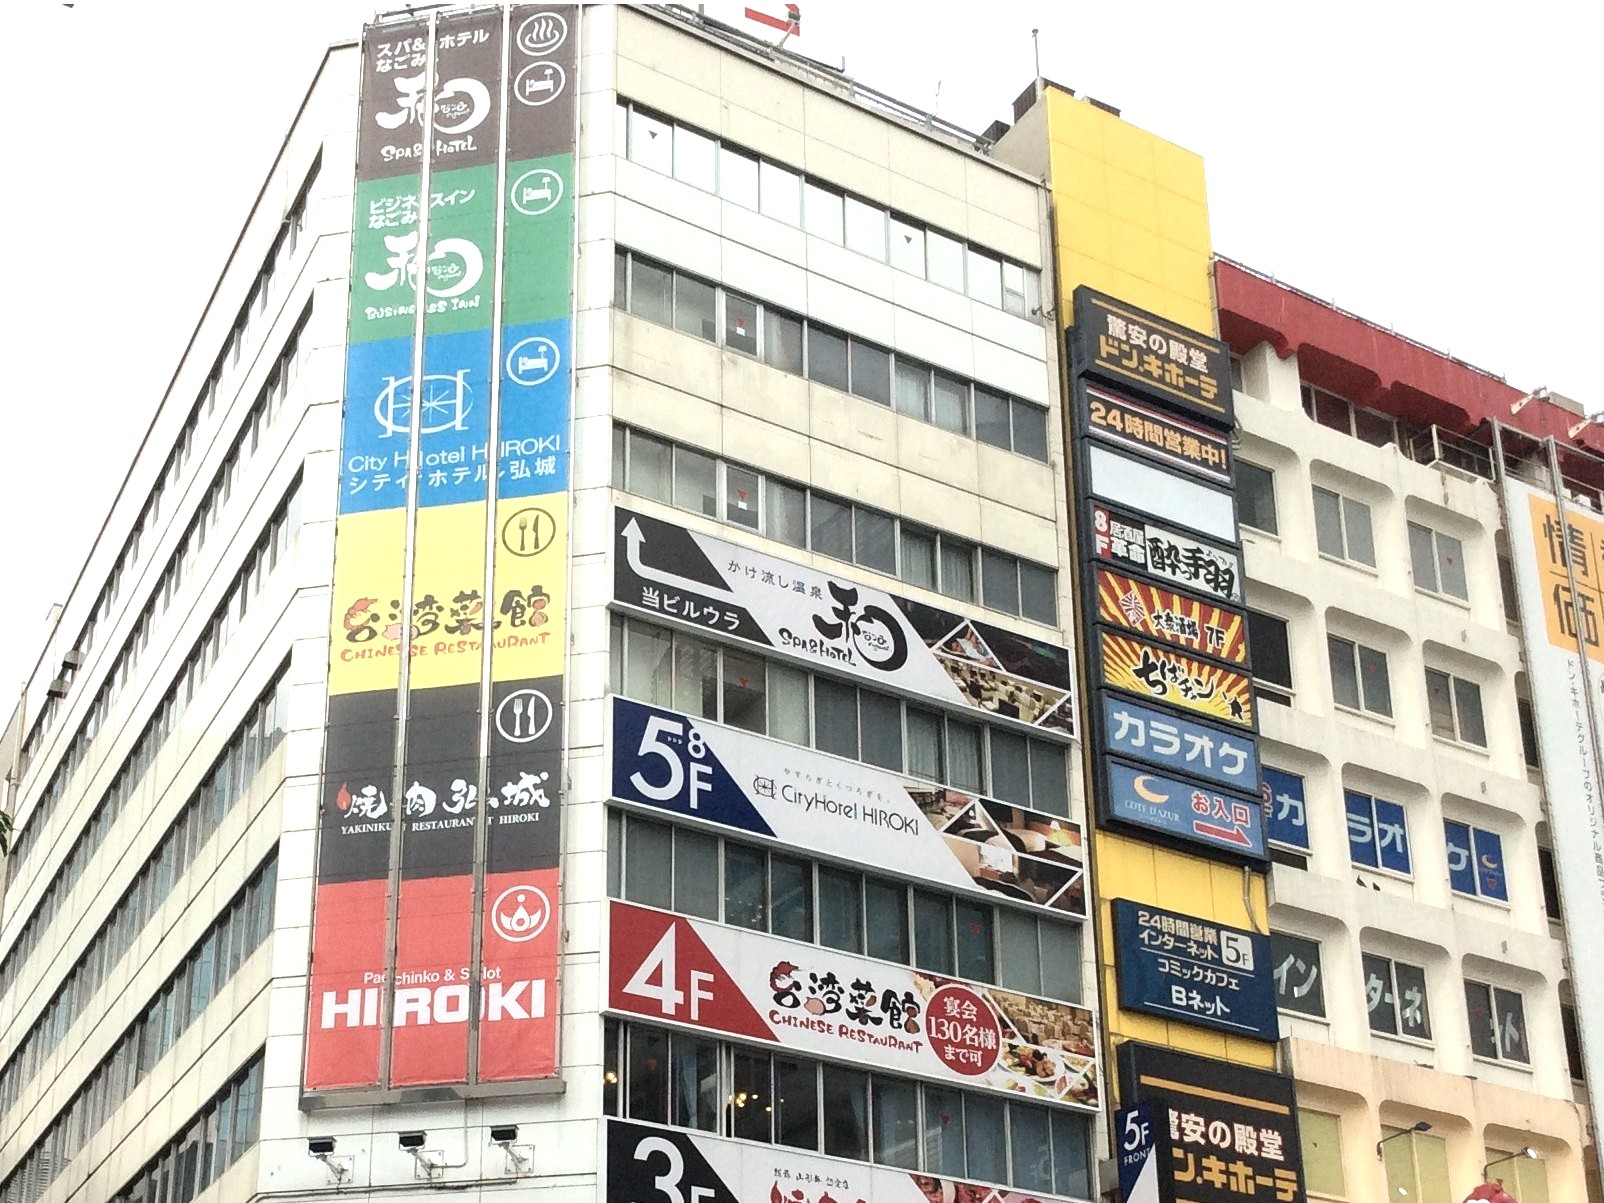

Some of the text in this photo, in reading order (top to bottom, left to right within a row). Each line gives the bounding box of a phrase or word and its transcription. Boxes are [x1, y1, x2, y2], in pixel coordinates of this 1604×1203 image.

[1107, 313, 1209, 373] 驚安の殿堂
[348, 435, 561, 475] City Hotel HIROKI
[728, 560, 824, 600] かけ流し温泉
[641, 586, 740, 631] 当ビルウラ
[340, 632, 551, 663] CHINESE RESTAURANT
[1112, 710, 1248, 776] カラオケ
[341, 812, 541, 836] YAKINIKU RESTAURANT HIROKI
[862, 804, 920, 837] HIROKI
[1191, 791, 1251, 829] お入口
[1138, 910, 1218, 946] 24時間営業
[1139, 928, 1219, 961] インターネット
[363, 966, 502, 985] Pachinko & Slot
[621, 921, 716, 1022] 4F
[1157, 958, 1241, 991] コミックカフェ
[320, 978, 546, 1029] HIROKI
[942, 995, 979, 1023] 宴会
[1171, 984, 1231, 1016] Bネット
[768, 1008, 924, 1054] CHINESE RESTAURANT
[928, 1015, 999, 1052] 130名様
[943, 1043, 984, 1069] まで可
